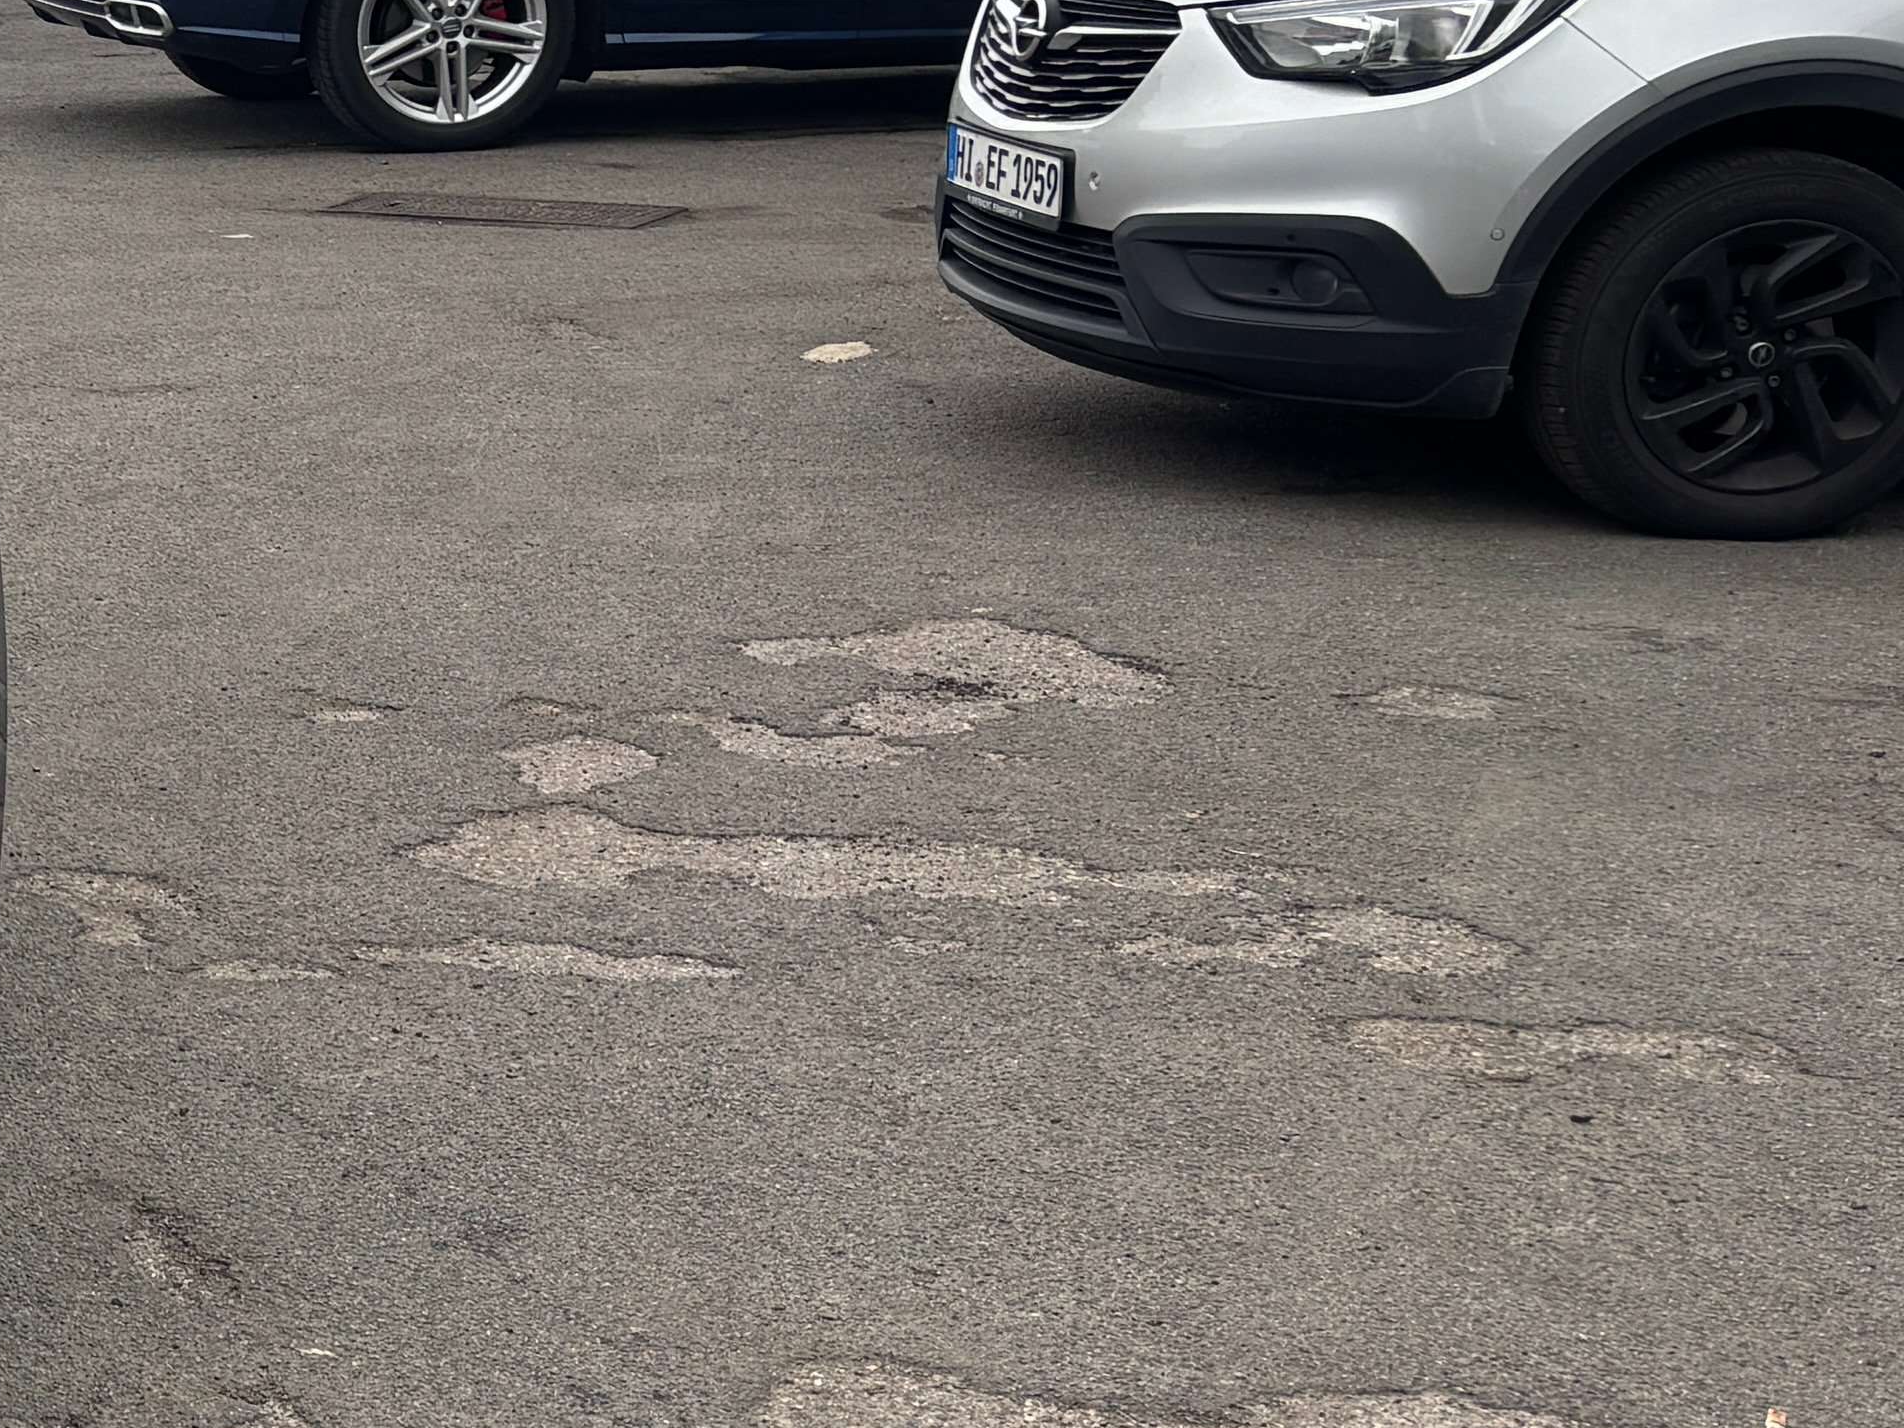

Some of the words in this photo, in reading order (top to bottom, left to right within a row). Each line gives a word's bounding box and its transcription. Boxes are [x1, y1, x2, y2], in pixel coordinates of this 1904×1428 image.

[956, 134, 974, 183] HI
[985, 144, 1010, 192] EF
[1010, 153, 1059, 208] 1959
